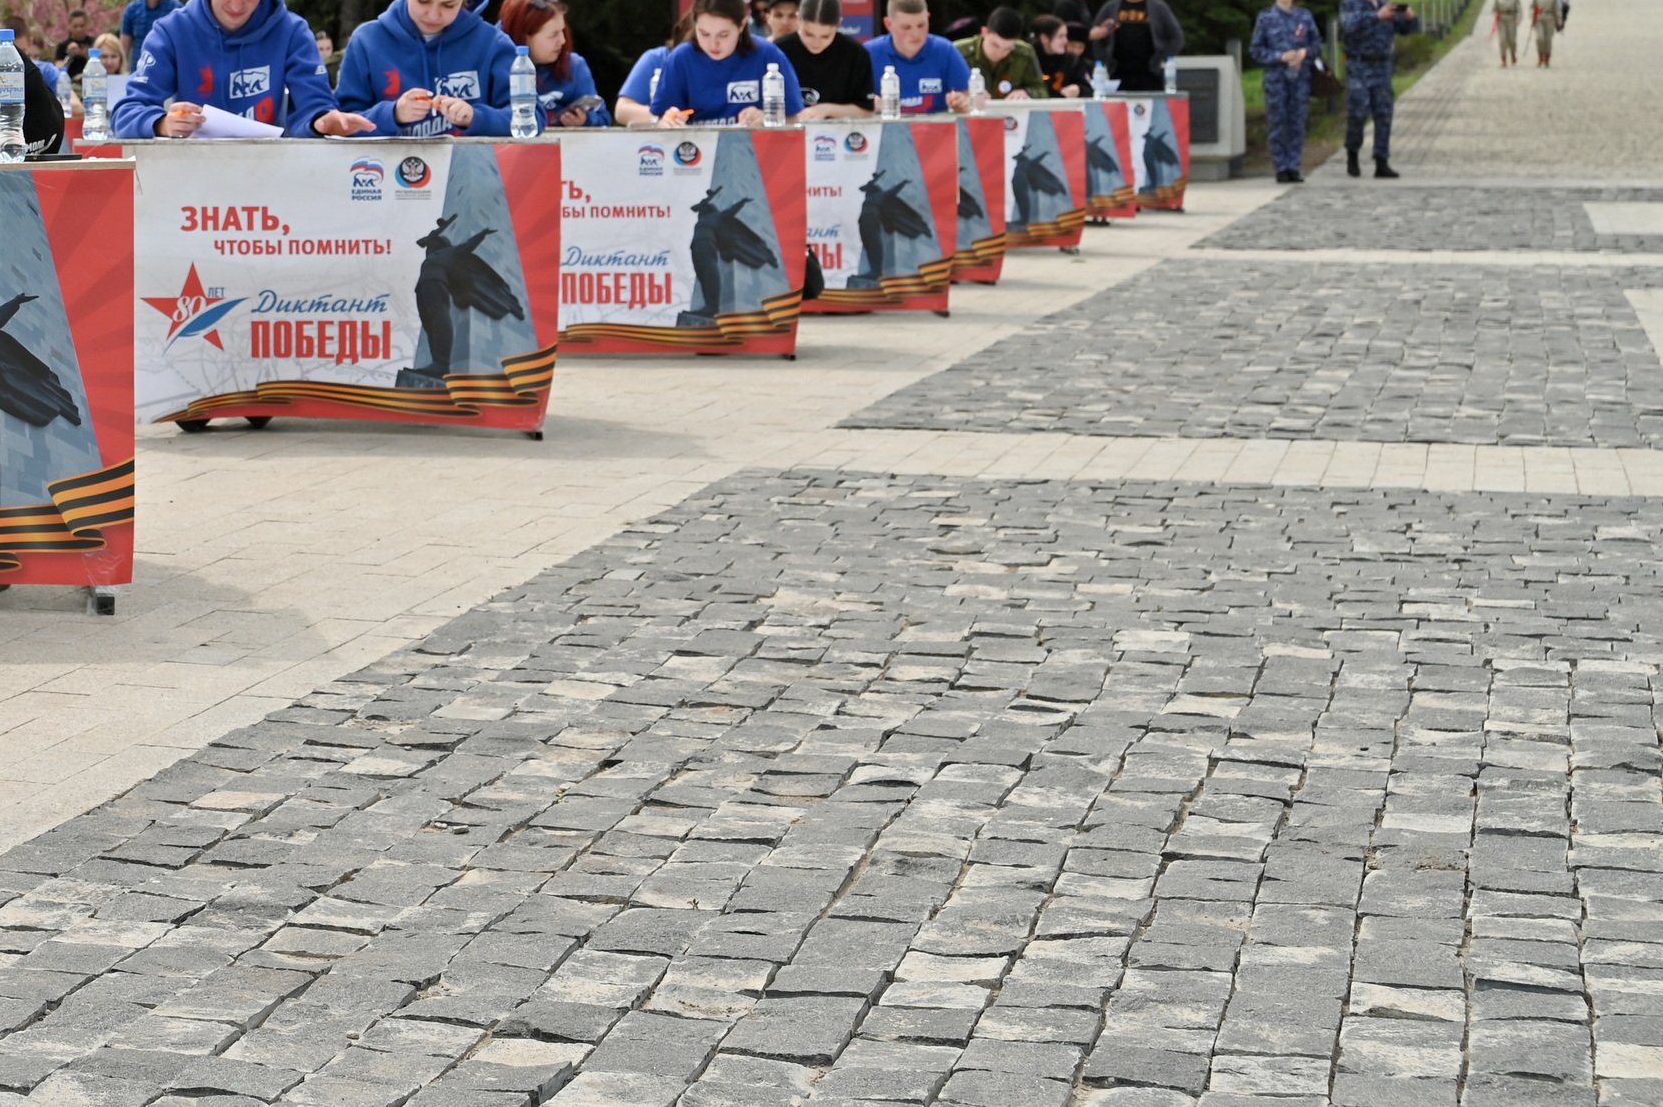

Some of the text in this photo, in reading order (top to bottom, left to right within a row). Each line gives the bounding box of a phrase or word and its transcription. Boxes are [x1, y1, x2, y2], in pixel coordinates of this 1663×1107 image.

[181, 206, 290, 236] ЗНАТЬ,
[590, 206, 671, 218] ПОМНИТЬ!
[214, 239, 392, 255] ЧТОБЫ ПОМНИТЬ!
[561, 246, 671, 267] Диктант
[208, 287, 225, 298] ЛЕТ
[251, 289, 390, 313] Диктант
[562, 272, 672, 310] ПОБЕДЫ
[172, 296, 207, 322] 80
[251, 321, 391, 366] ПОБЕДЫ
